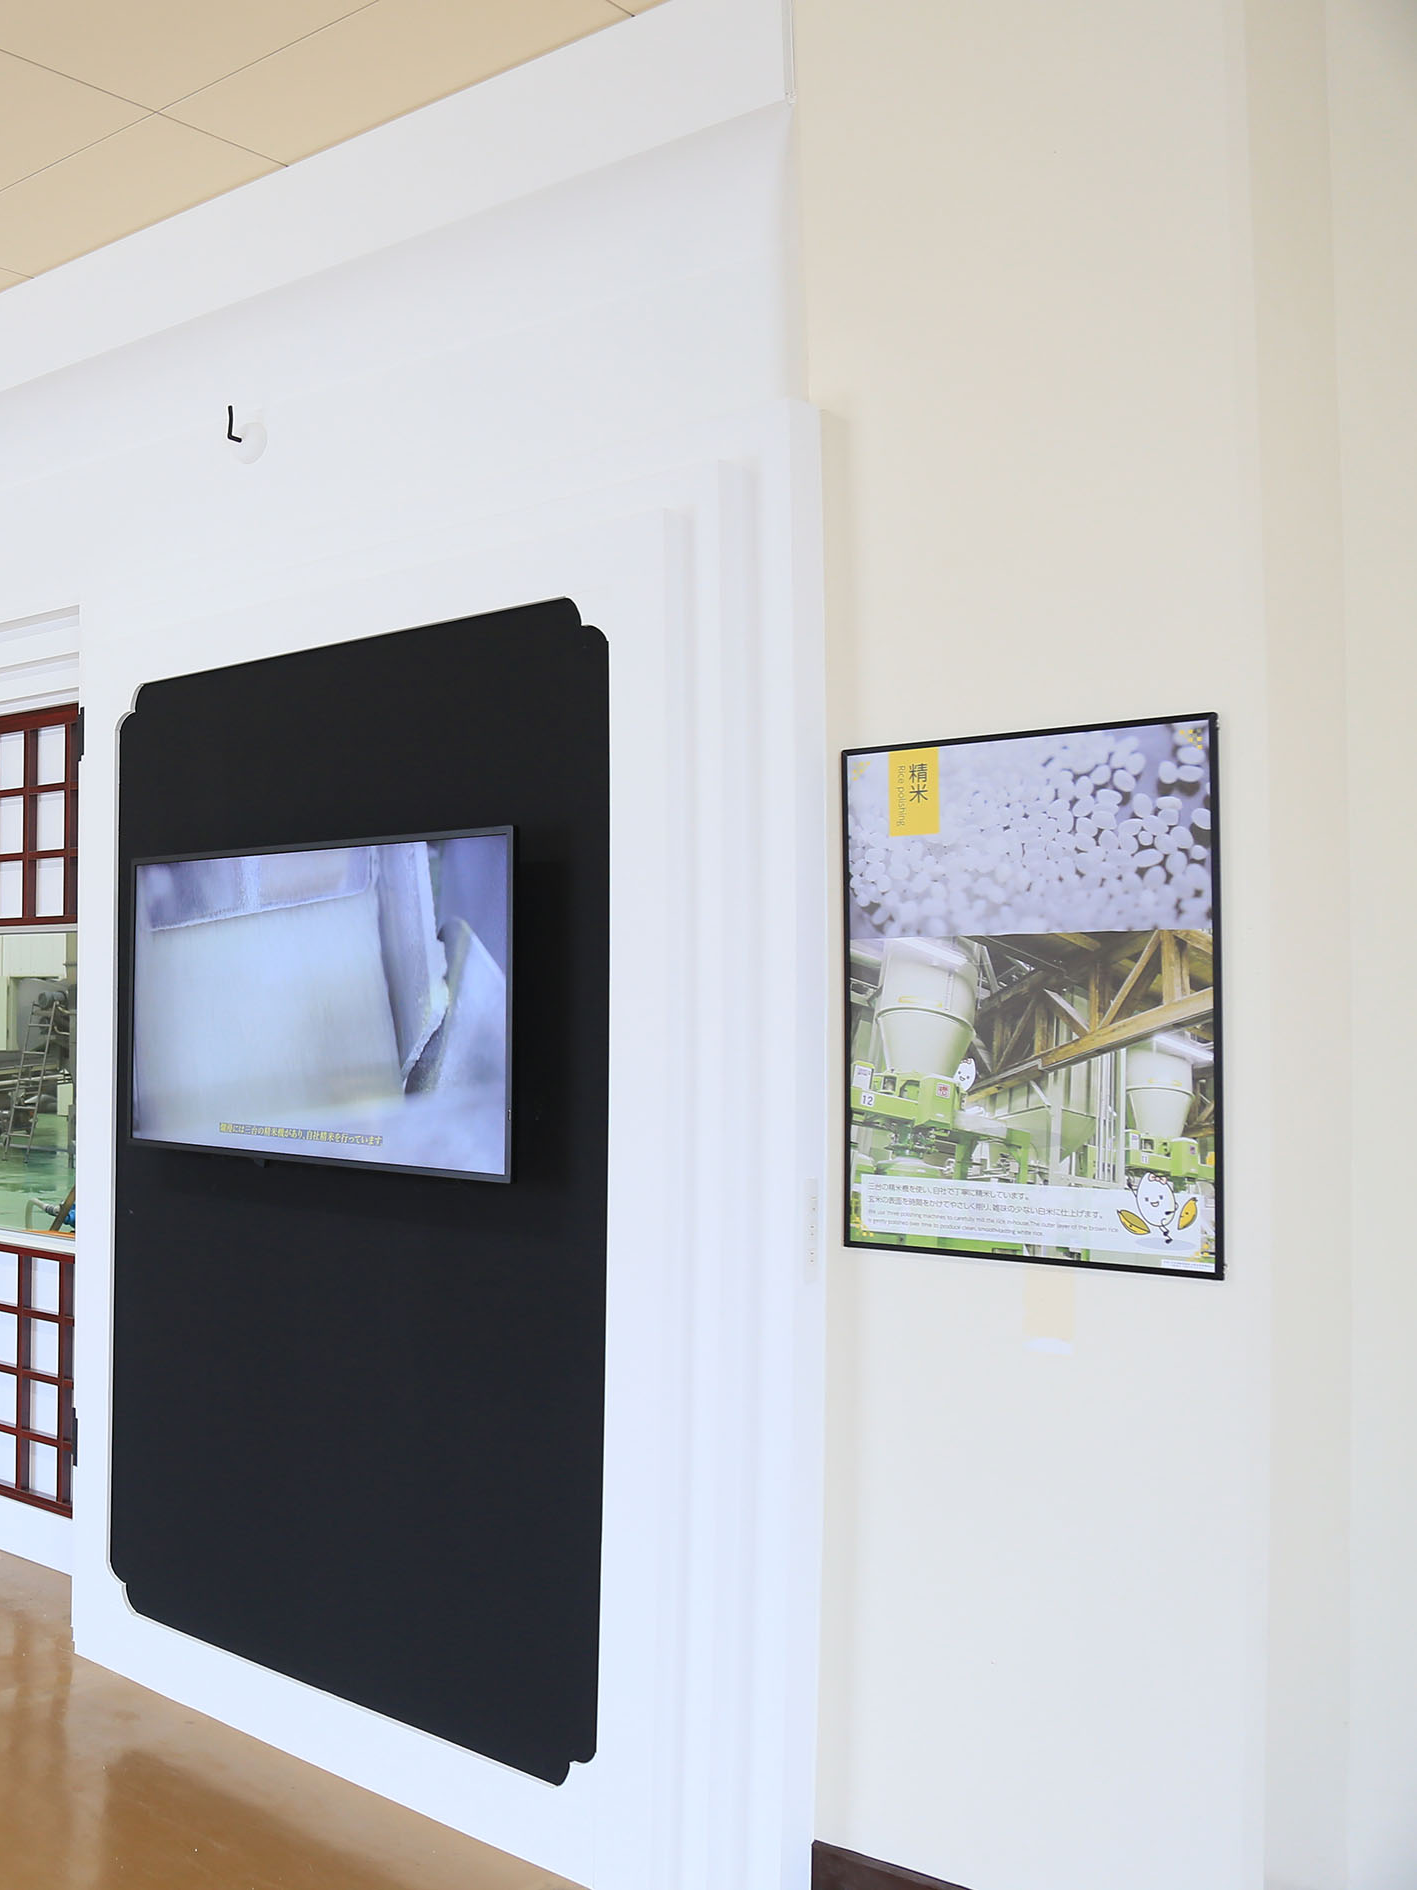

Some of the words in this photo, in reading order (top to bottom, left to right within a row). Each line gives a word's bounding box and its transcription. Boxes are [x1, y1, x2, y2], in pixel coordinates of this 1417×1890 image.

[897, 765, 906, 784] Rice
[909, 763, 928, 803] 精米
[896, 787, 907, 827] polishing
[862, 1094, 874, 1106] 12
